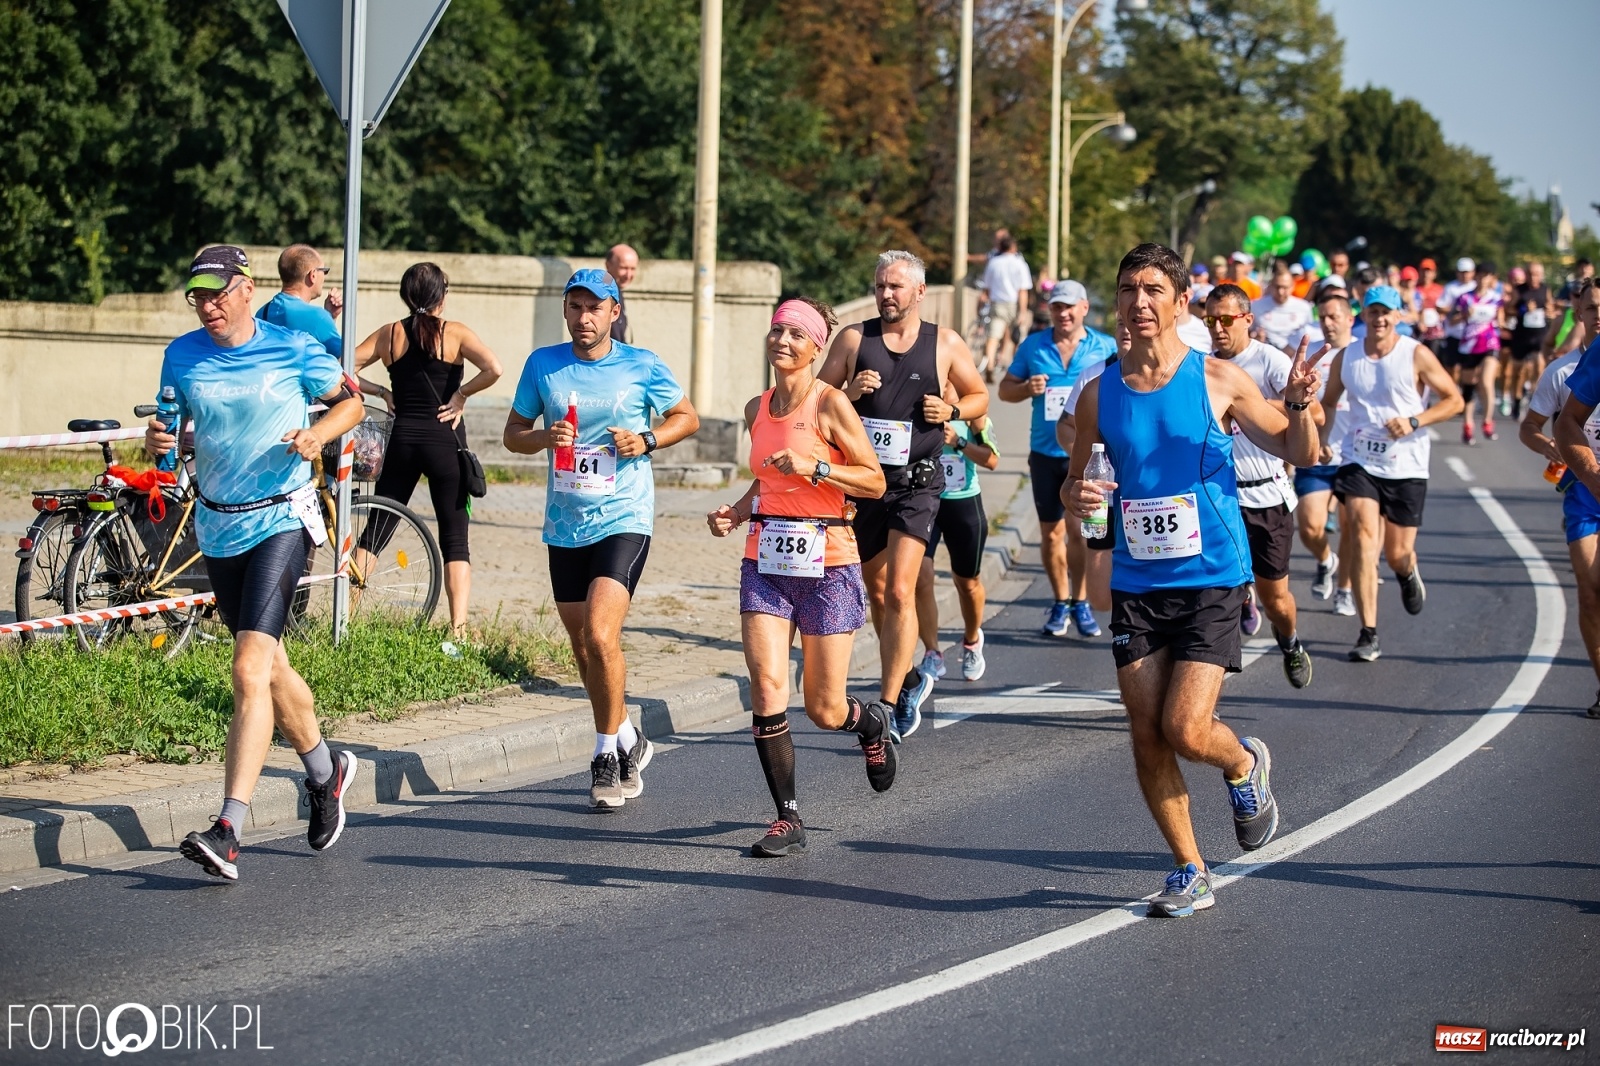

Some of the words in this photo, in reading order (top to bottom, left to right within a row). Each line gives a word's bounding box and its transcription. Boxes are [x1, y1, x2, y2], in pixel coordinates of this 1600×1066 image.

[190, 381, 259, 400] DeLuxus
[549, 391, 612, 408] Deuxus
[873, 431, 892, 447] 98
[1367, 440, 1387, 453] 123
[1141, 513, 1179, 536] 385
[775, 536, 807, 554] 258
